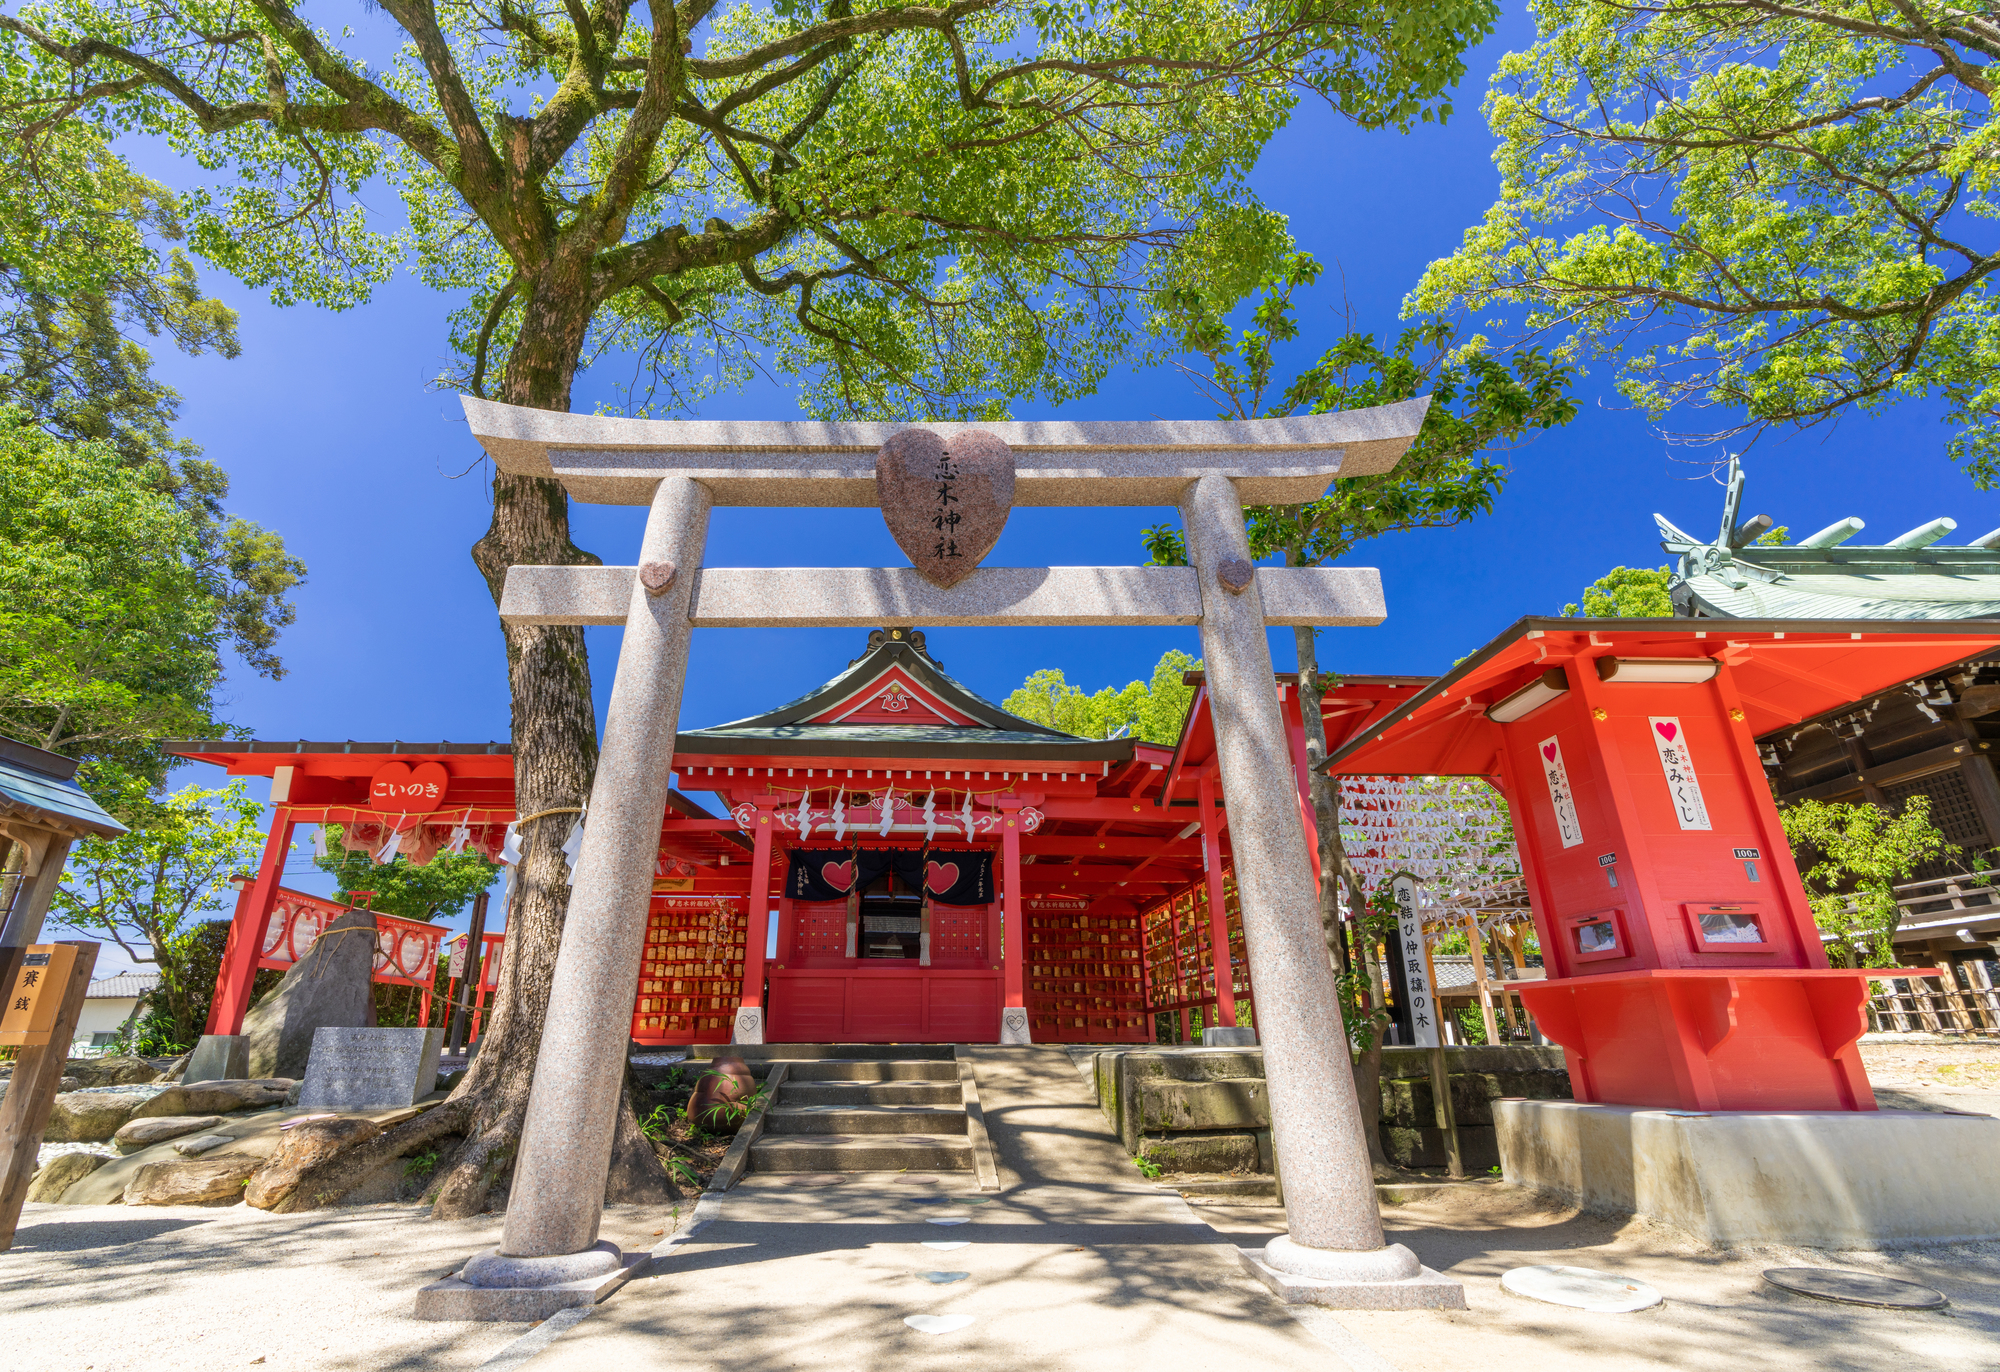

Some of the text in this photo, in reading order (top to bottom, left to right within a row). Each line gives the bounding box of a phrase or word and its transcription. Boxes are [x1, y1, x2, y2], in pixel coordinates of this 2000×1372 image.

[931, 450, 963, 560] 恋木神社
[1556, 762, 1572, 801] 恋木神社
[1677, 743, 1696, 784] 恋木神社
[373, 782, 440, 799] こいのき
[1548, 769, 1573, 841] 恋みくじ
[1661, 747, 1695, 824] 恋みくじ
[1737, 849, 1758, 858] 100円
[676, 899, 716, 908] 恋木祈願絵
[13, 969, 40, 1012] 賽銭
